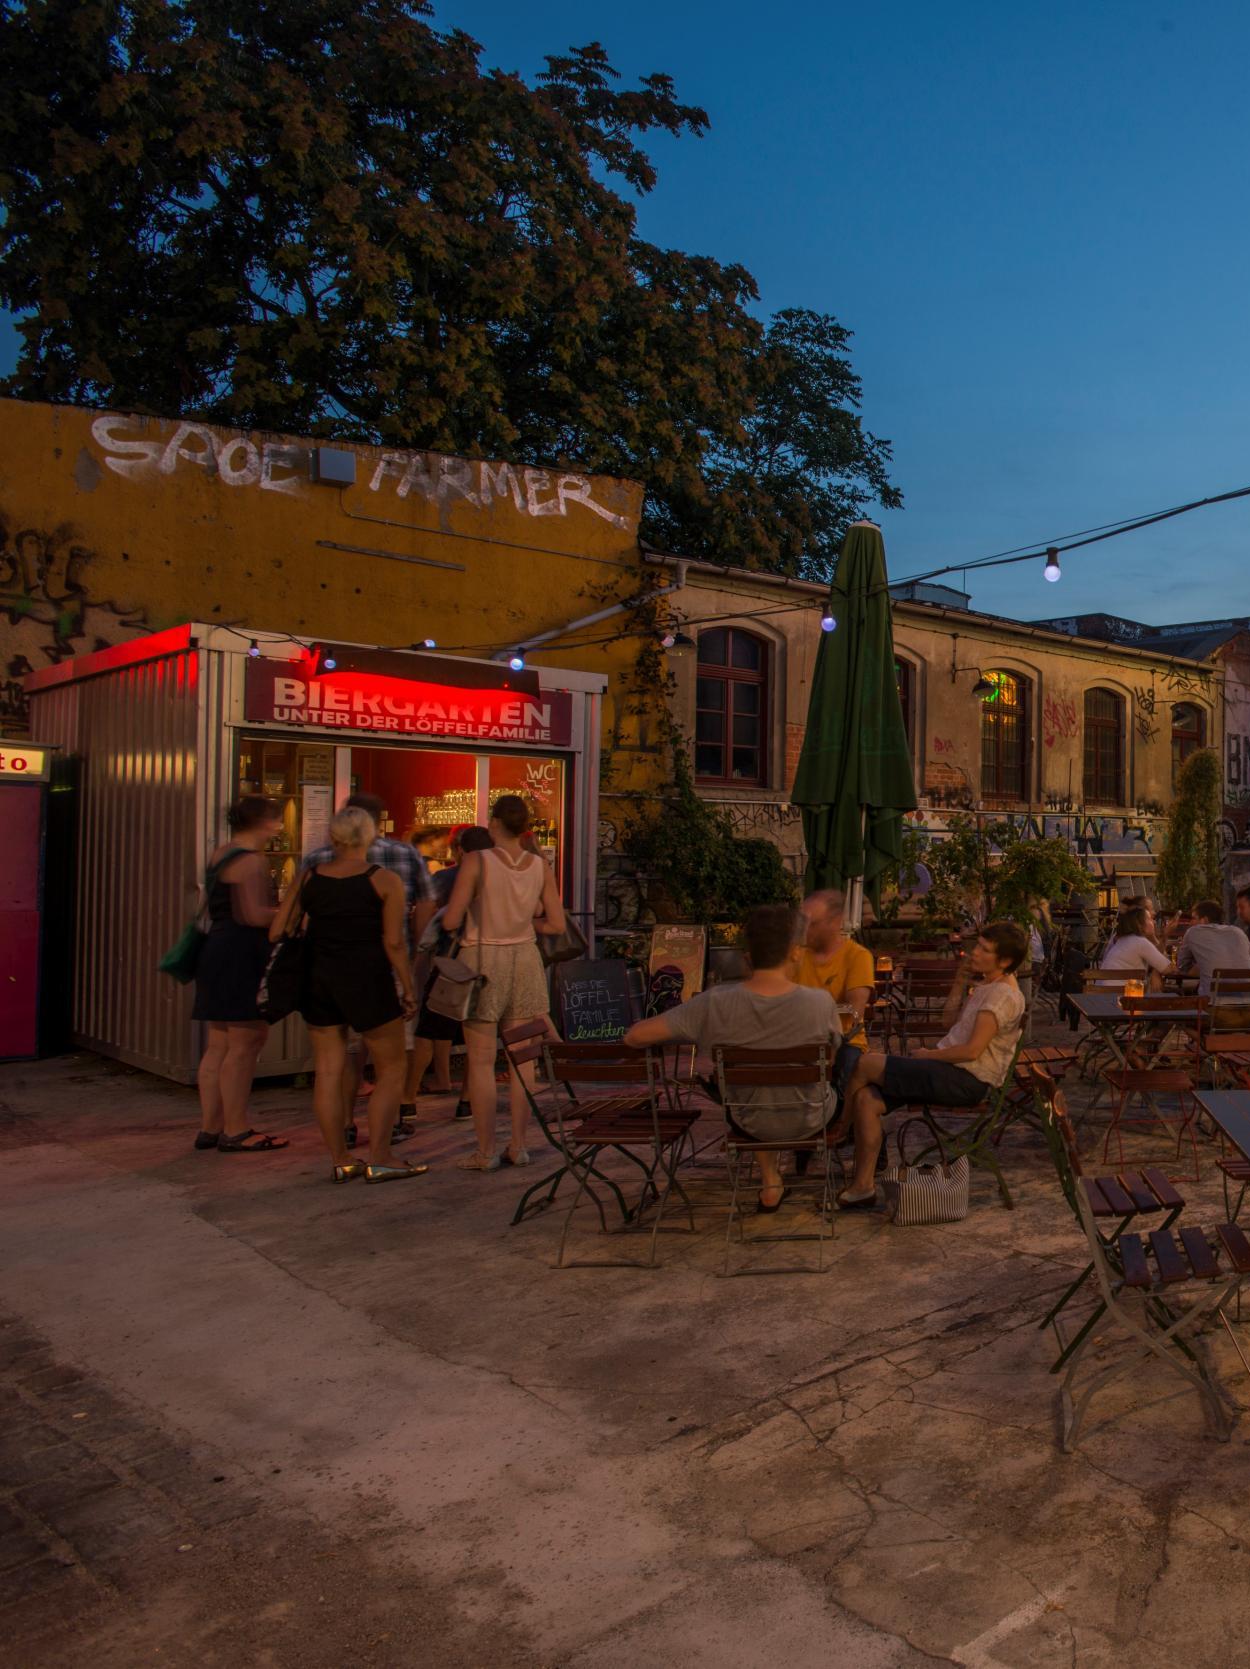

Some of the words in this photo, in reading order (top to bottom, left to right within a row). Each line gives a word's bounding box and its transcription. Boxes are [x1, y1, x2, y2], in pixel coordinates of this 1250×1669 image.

[273, 707, 350, 726] UNTER
[355, 714, 400, 730] DER
[404, 715, 552, 741] LÖFFELFAMILIE
[526, 763, 557, 781] WC
